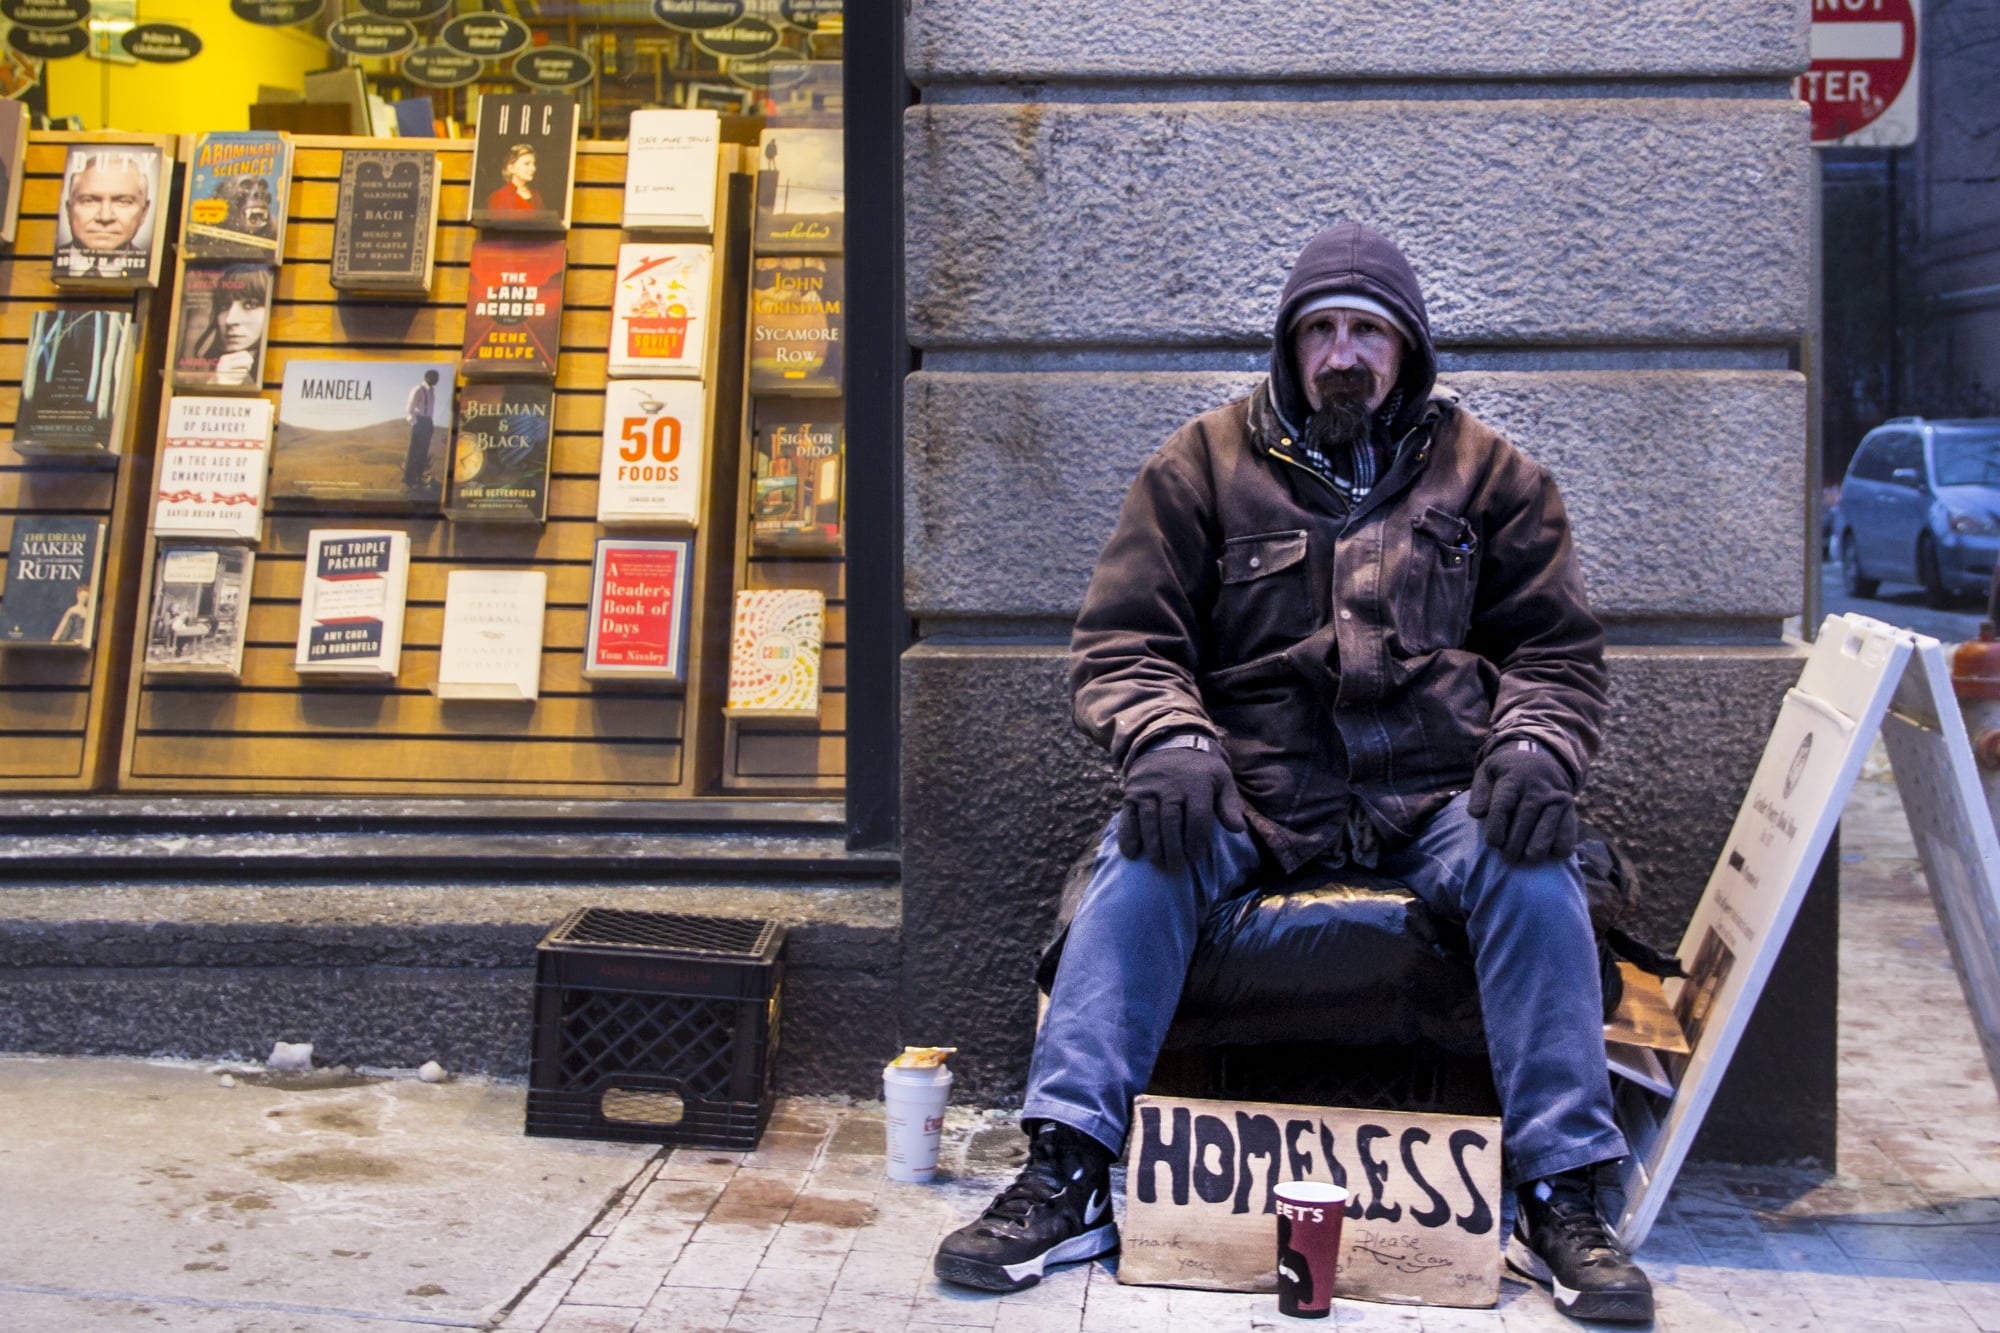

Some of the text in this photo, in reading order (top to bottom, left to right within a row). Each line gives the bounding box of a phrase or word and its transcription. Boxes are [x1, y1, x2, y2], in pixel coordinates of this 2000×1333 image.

[365, 209, 404, 220] BACH
[362, 231, 390, 239] MUSIC
[355, 241, 408, 250] THE CASTLE
[355, 252, 366, 260] OF
[501, 272, 528, 284] THE
[773, 272, 824, 292] JOHN
[487, 286, 539, 301] LAND
[475, 302, 547, 317] ACROSS
[753, 299, 841, 315] GRISHAM
[488, 332, 528, 345] GENE
[633, 333, 679, 349] SOVIET
[754, 325, 840, 342] SYCAMORE
[478, 346, 535, 360] WOLFE
[300, 378, 373, 401] MANDELA
[182, 405, 252, 417] THE PROBLEM
[466, 399, 547, 420] BELLMAN
[184, 421, 246, 433] OF SLAVERY
[498, 418, 510, 433] &
[477, 431, 531, 451] BLACK
[619, 416, 682, 463] 50
[779, 432, 834, 446] SIGNOR
[795, 445, 833, 458] DIDO
[172, 455, 248, 468] IN THE AGE OF
[171, 471, 246, 483] EMANCIPATION
[618, 465, 680, 483] FOODS
[460, 488, 484, 498] DIANE
[24, 532, 87, 543] THE DREAM
[21, 541, 85, 556] MAKER
[323, 541, 387, 557] THE TRIPLE
[16, 559, 84, 581] RUFIN
[327, 556, 379, 571] PACKAGE
[606, 562, 619, 577] A
[605, 581, 671, 598] Reader's
[603, 599, 671, 616] Book of
[324, 629, 369, 642] AMY CHUA
[602, 618, 640, 639] Days
[328, 641, 379, 655] RUBENFELD
[600, 649, 665, 665] Tom Nissley
[1136, 1106, 1494, 1236] HOMELESS
